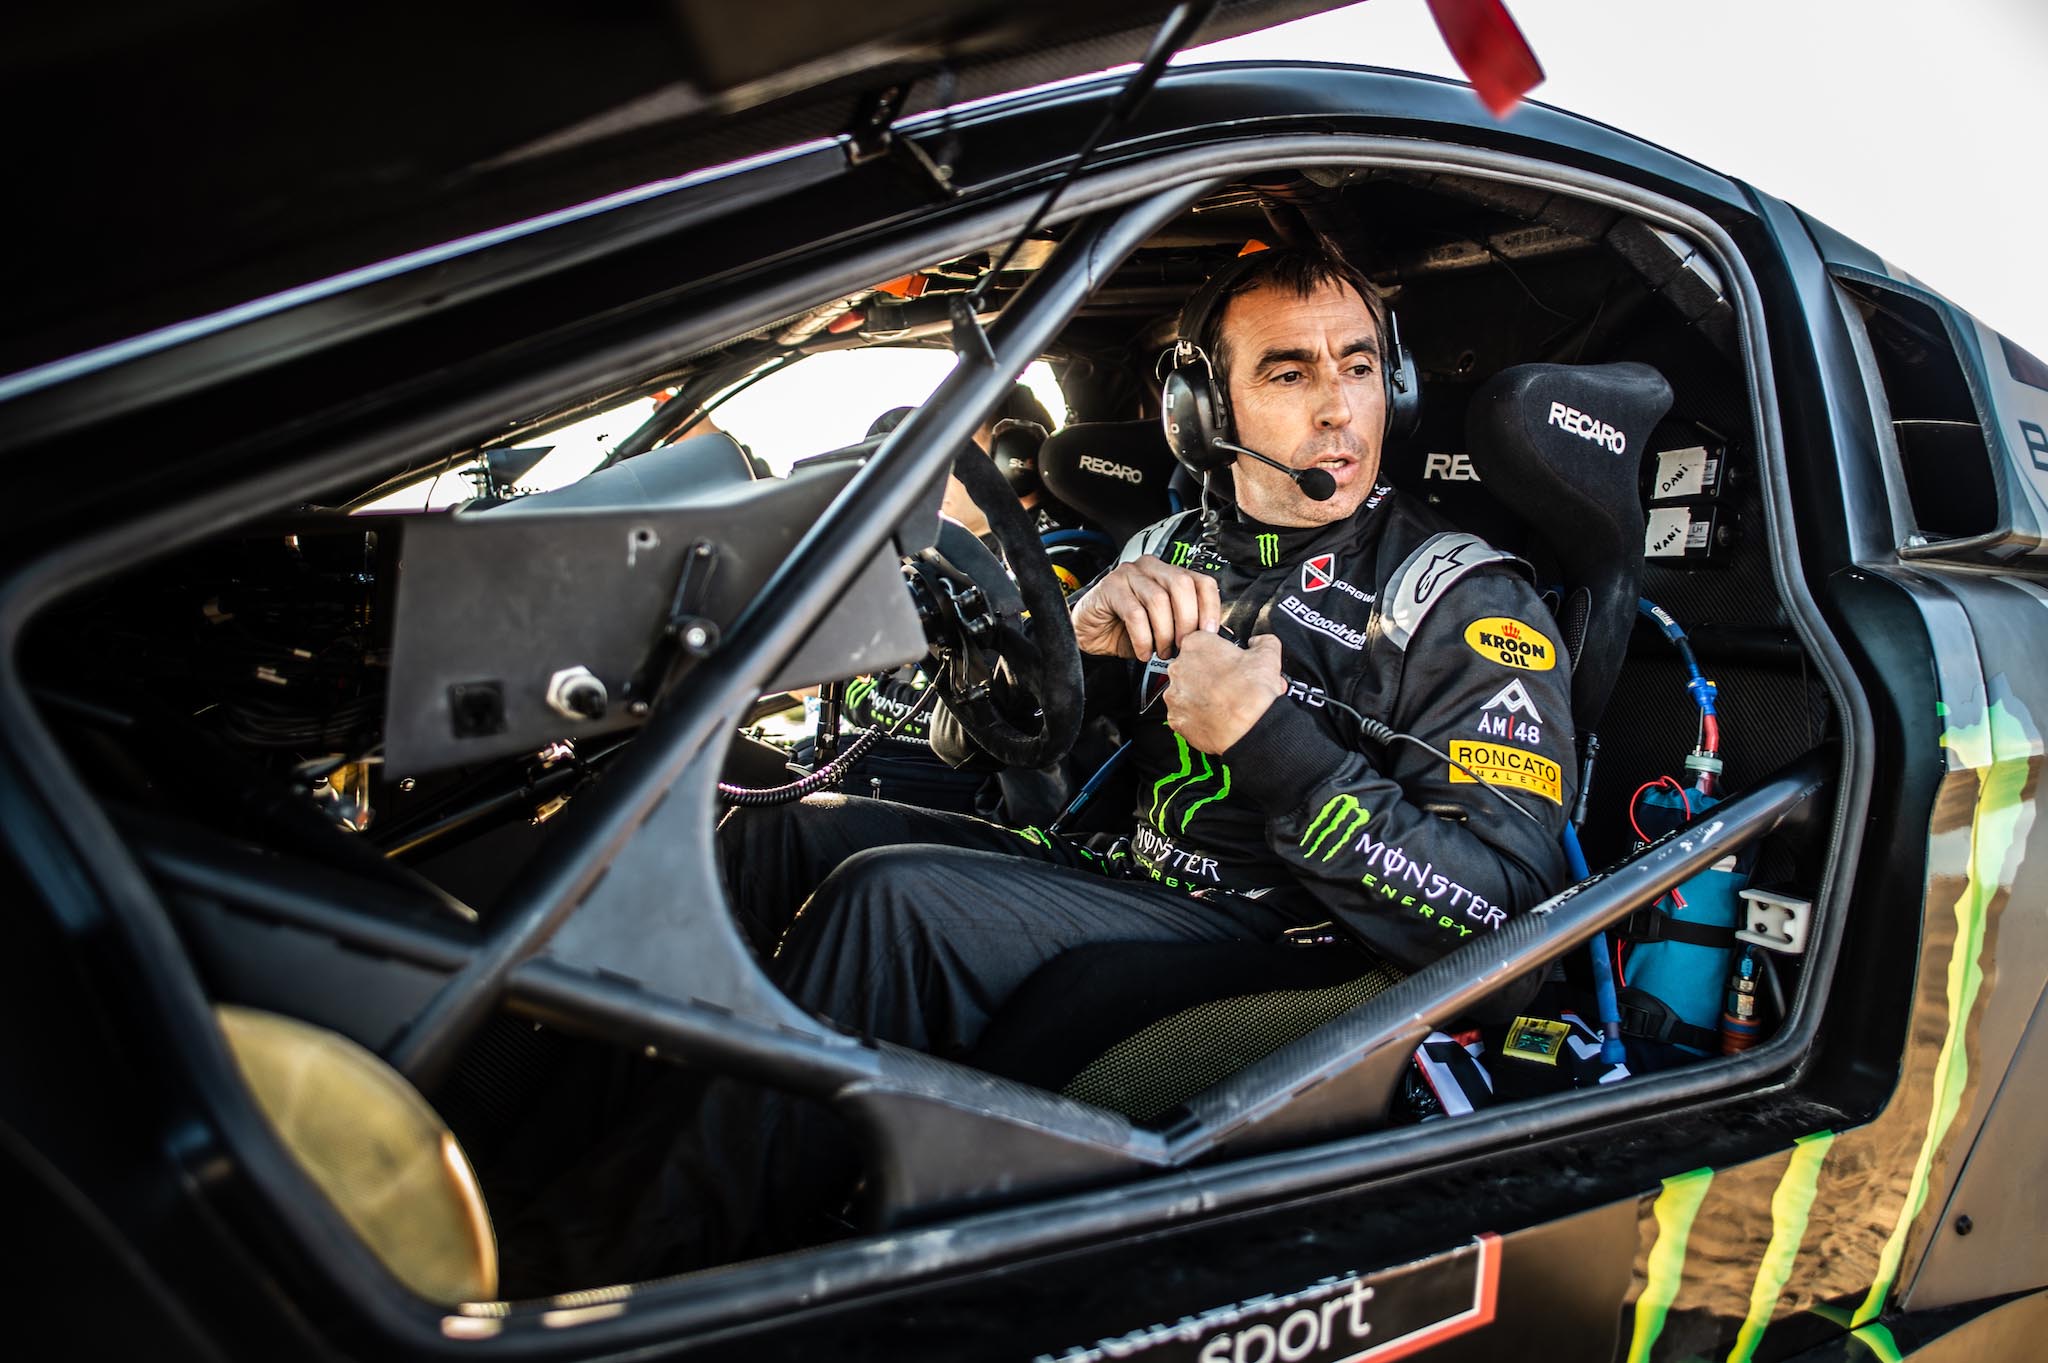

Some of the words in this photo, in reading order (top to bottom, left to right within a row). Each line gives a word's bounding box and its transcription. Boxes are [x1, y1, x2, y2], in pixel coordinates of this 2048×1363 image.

[1547, 401, 1626, 455] RECARO
[1078, 454, 1143, 485] RECARO
[1282, 595, 1367, 646] BFGoodrich
[1479, 631, 1546, 659] KROON
[1499, 651, 1530, 668] OIL
[870, 709, 922, 734] ENEGY
[1459, 746, 1557, 783] RONCATO
[1476, 770, 1556, 797] MALETAS
[1355, 833, 1508, 931] MONSTER
[1361, 873, 1473, 938] ENERGY
[1200, 1280, 1374, 1363] sport
